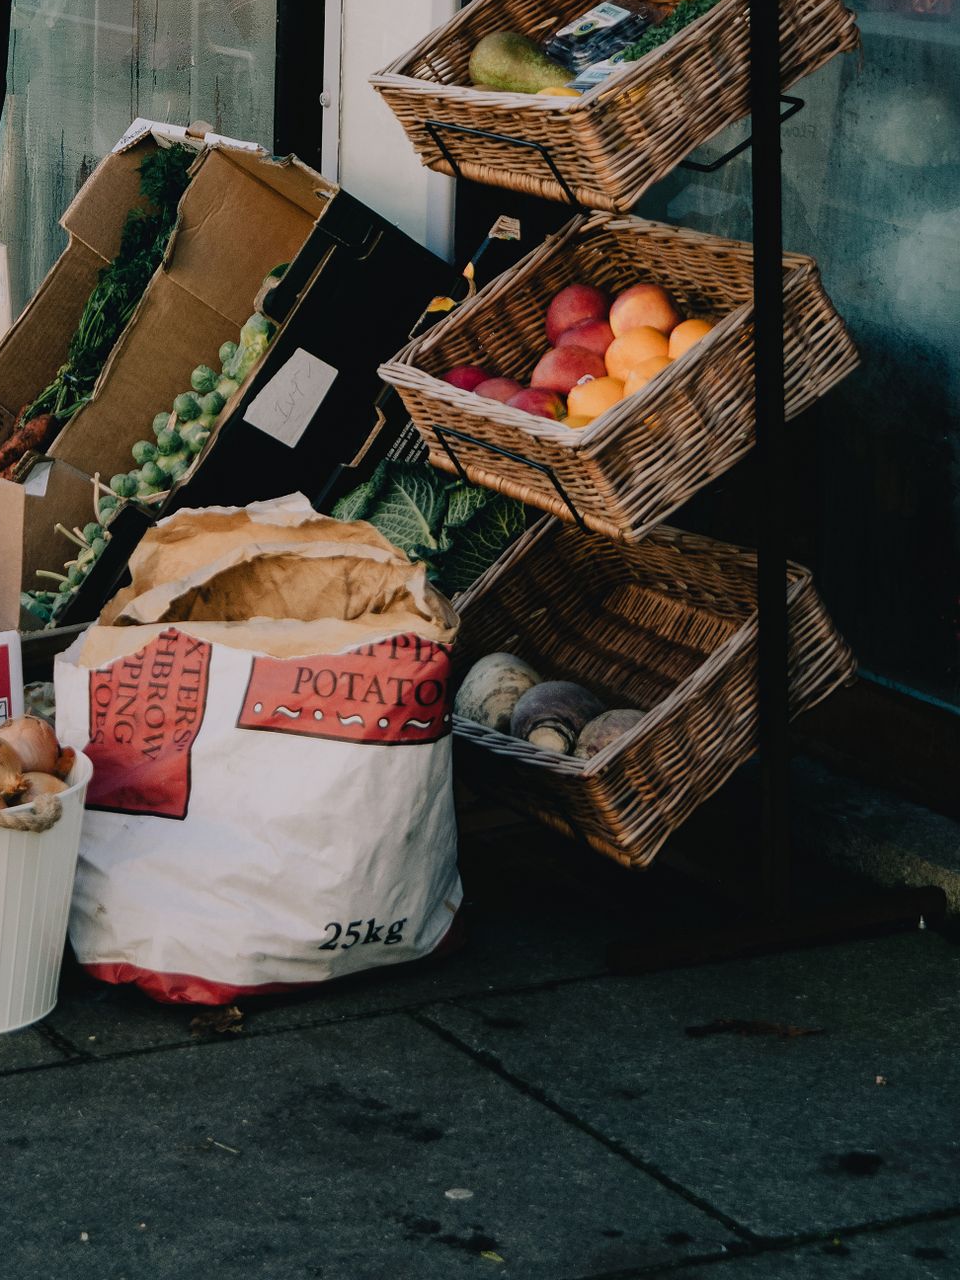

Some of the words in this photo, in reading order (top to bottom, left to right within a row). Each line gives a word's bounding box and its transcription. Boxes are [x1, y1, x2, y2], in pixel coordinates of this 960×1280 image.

[142, 630, 181, 761] HBROW
[173, 637, 206, 752] XTERS"
[318, 917, 409, 951] 25kg
